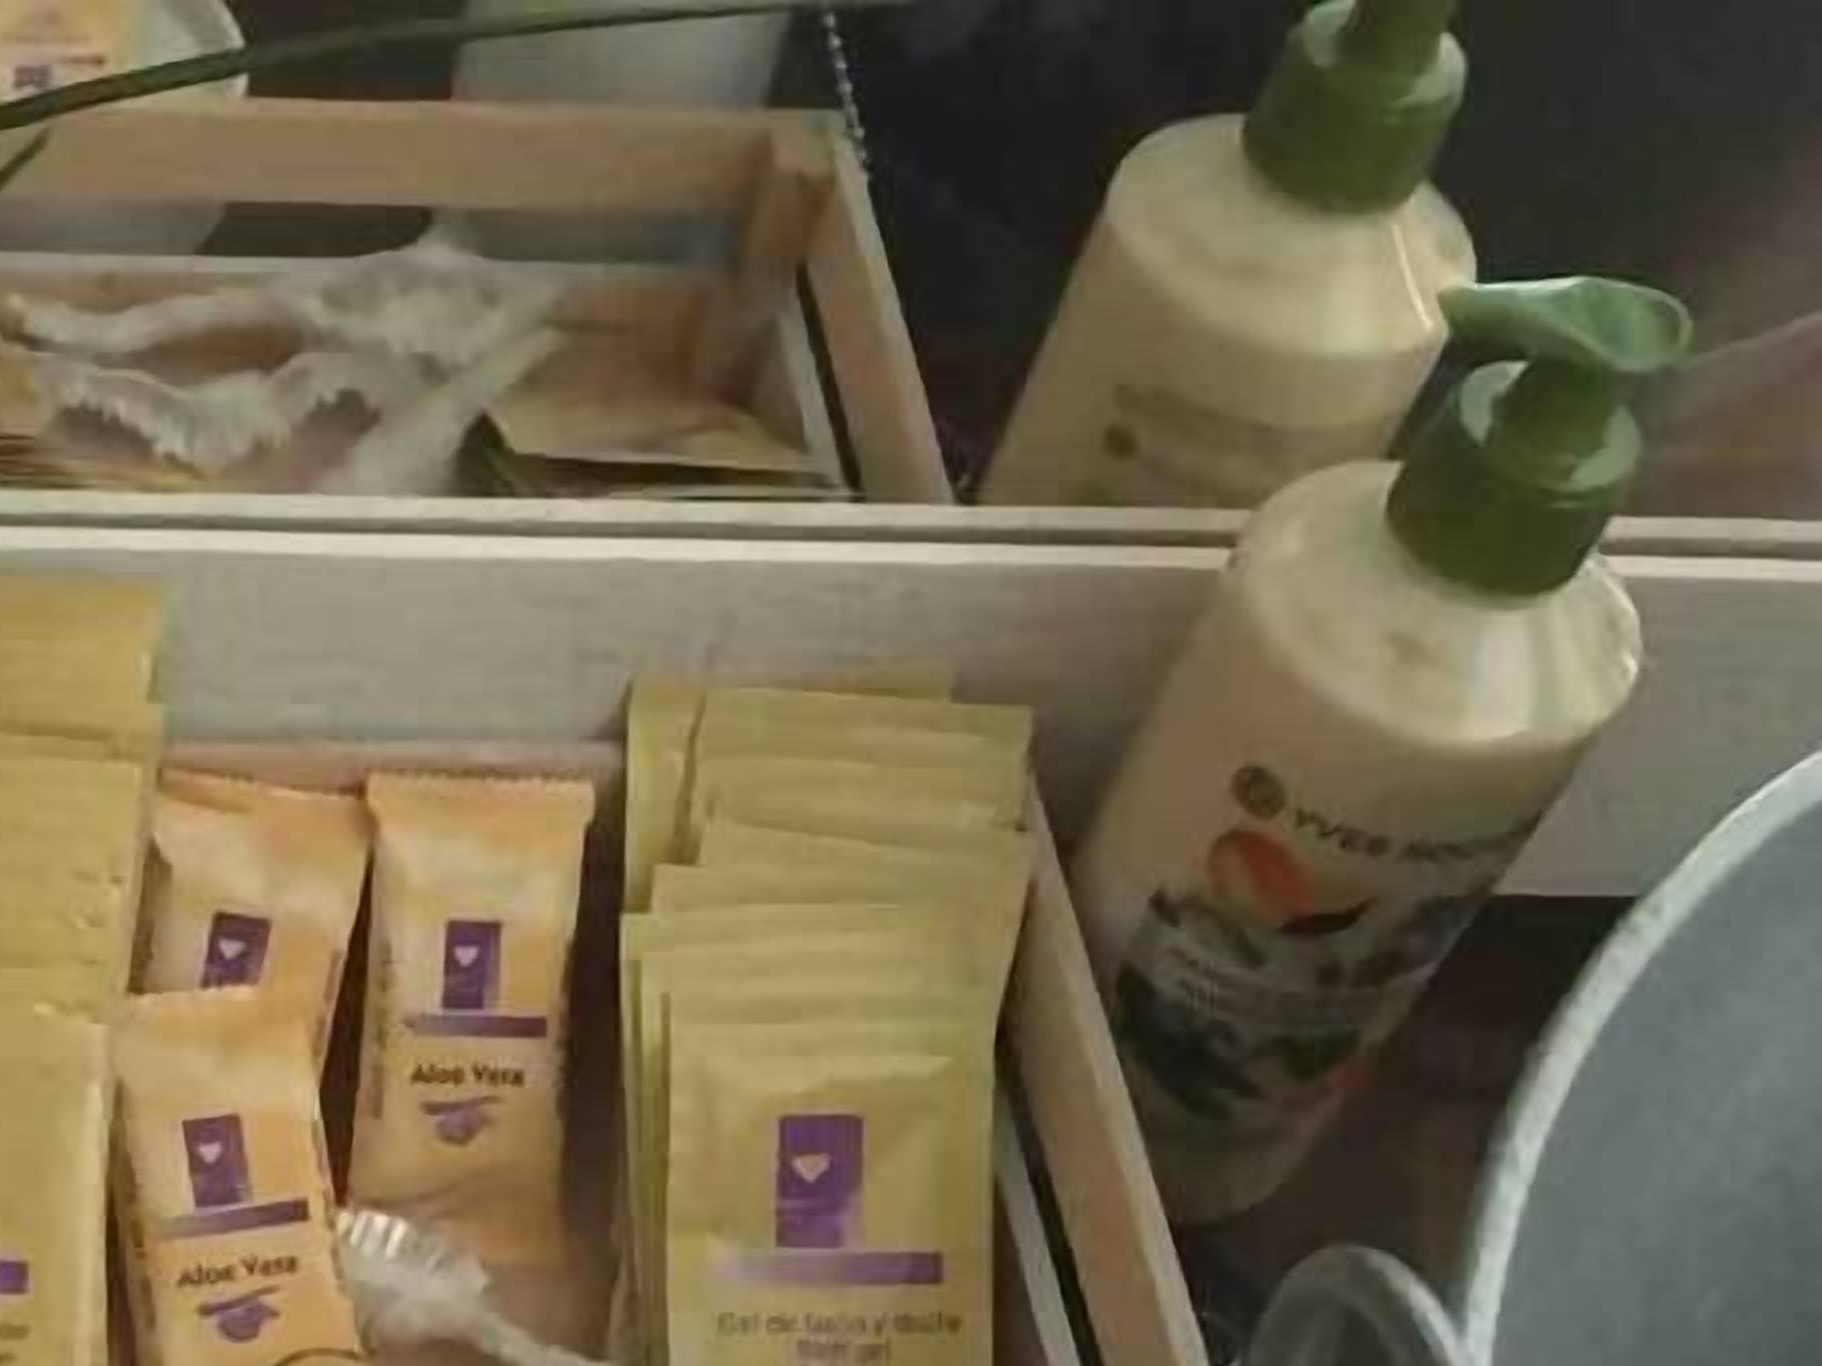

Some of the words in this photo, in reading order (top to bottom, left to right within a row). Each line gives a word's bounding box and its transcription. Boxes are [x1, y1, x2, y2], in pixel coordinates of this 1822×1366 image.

[409, 1062, 466, 1088] Aloe
[470, 1062, 526, 1088] Vera
[176, 1263, 237, 1288] Aloe
[238, 1254, 298, 1277] Vera
